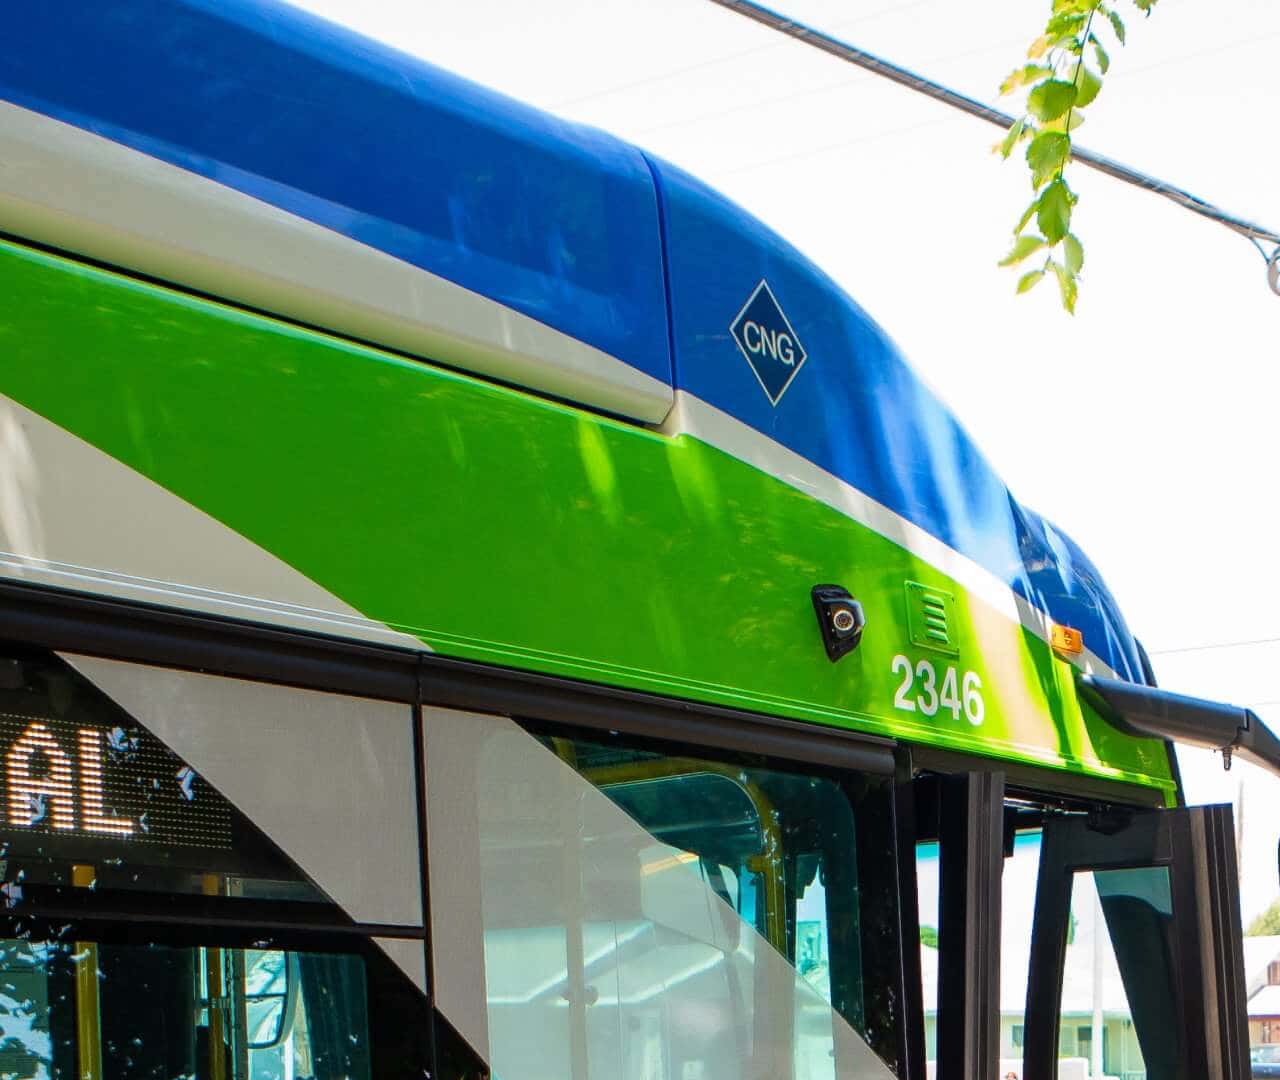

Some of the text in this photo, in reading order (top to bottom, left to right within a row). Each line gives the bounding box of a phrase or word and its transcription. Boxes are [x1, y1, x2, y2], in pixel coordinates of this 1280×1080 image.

[743, 320, 795, 366] CNG
[892, 654, 985, 726] 2346
[6, 723, 134, 835] AL
